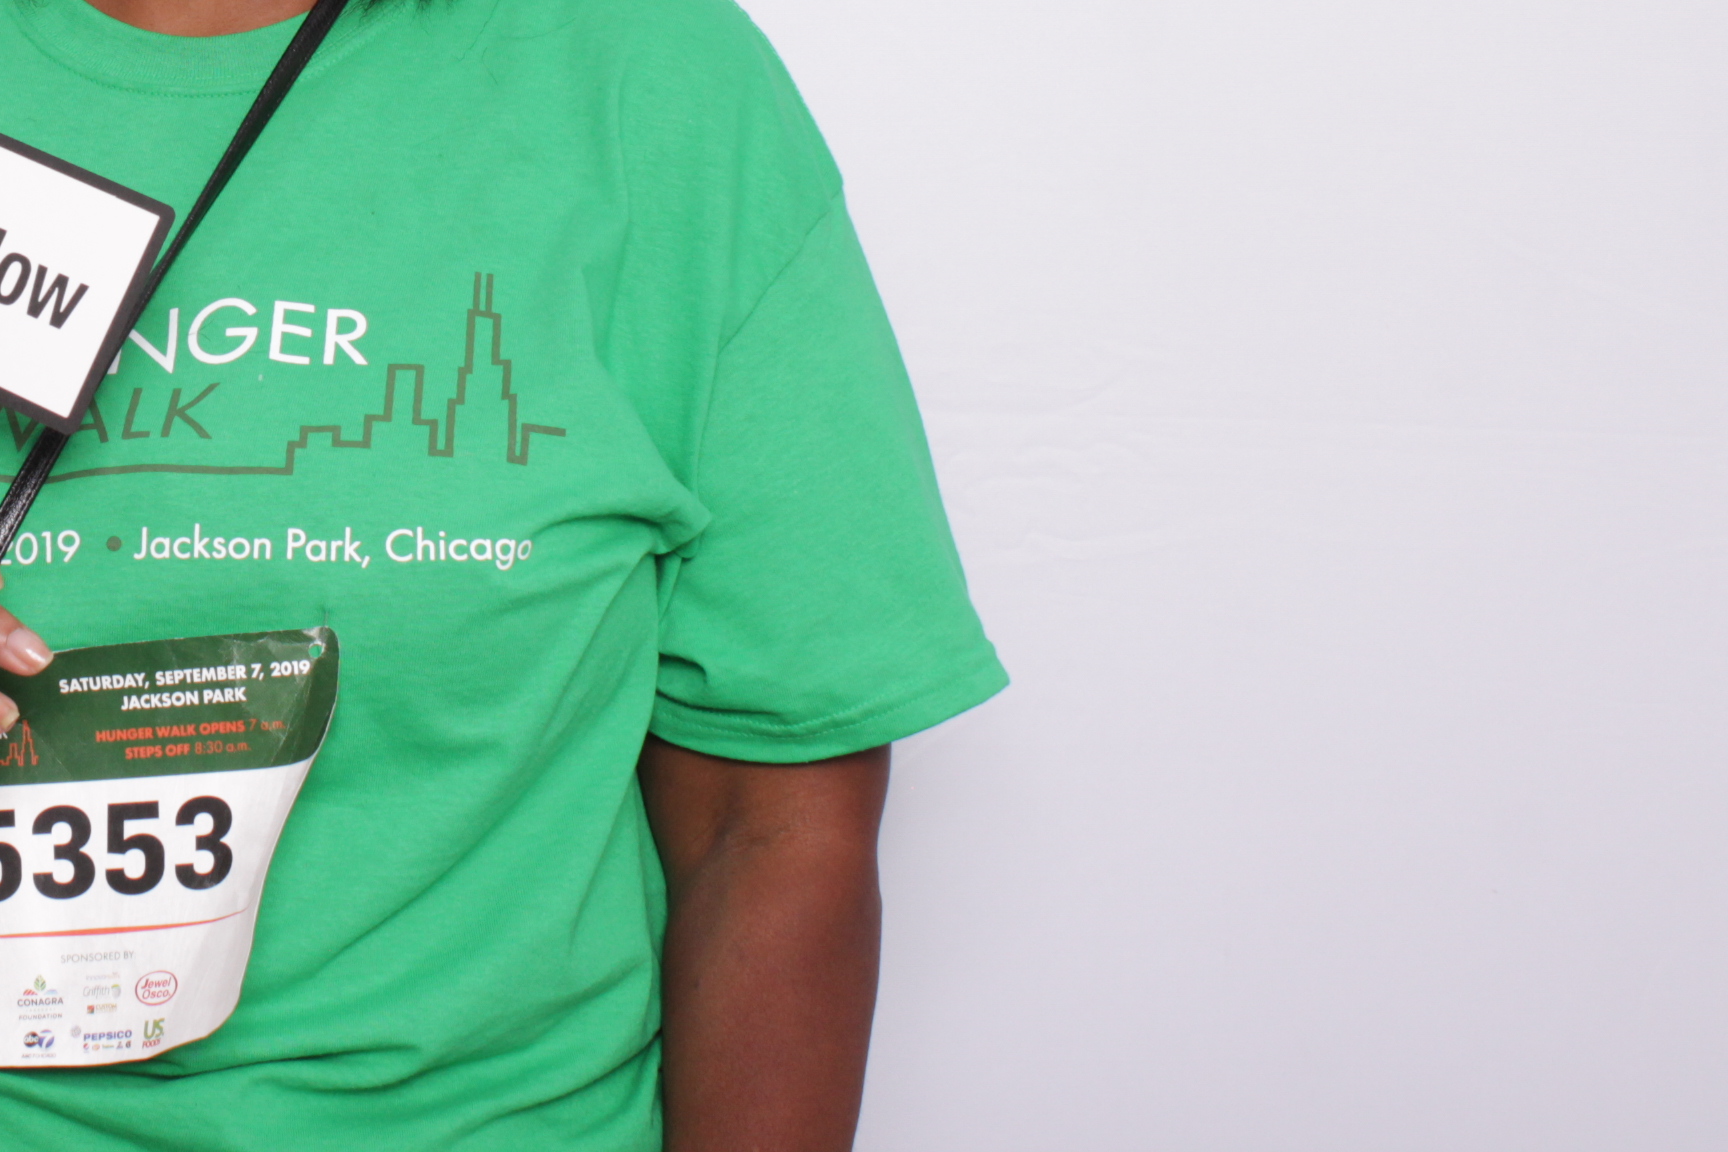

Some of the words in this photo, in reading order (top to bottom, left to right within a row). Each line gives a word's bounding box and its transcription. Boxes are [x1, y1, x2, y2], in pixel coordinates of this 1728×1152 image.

[106, 297, 369, 375] NGER
[133, 523, 272, 561] Jackson
[286, 527, 370, 569] Park,
[386, 526, 533, 571] Chicago
[59, 672, 150, 694] SATURDAY,
[155, 664, 247, 686] SEPTEMBER
[250, 663, 266, 680] 7,
[270, 659, 312, 677] 2019
[121, 690, 200, 711] JACKSON
[203, 687, 247, 705] PARK
[95, 727, 154, 743] HUNGER
[156, 724, 197, 738] WALK
[199, 720, 246, 735] OPENS
[249, 719, 257, 731] 7
[125, 745, 163, 760] STEPS
[165, 744, 191, 757] OFF
[194, 741, 223, 755] 8:30
[227, 742, 252, 753] a.m.
[60, 951, 121, 964] SPONSORED
[141, 977, 172, 991] Jewel
[17, 997, 64, 1007] CONAGRA
[18, 1013, 63, 1021] FOUNDATION
[83, 1029, 133, 1042] PEPSICO
